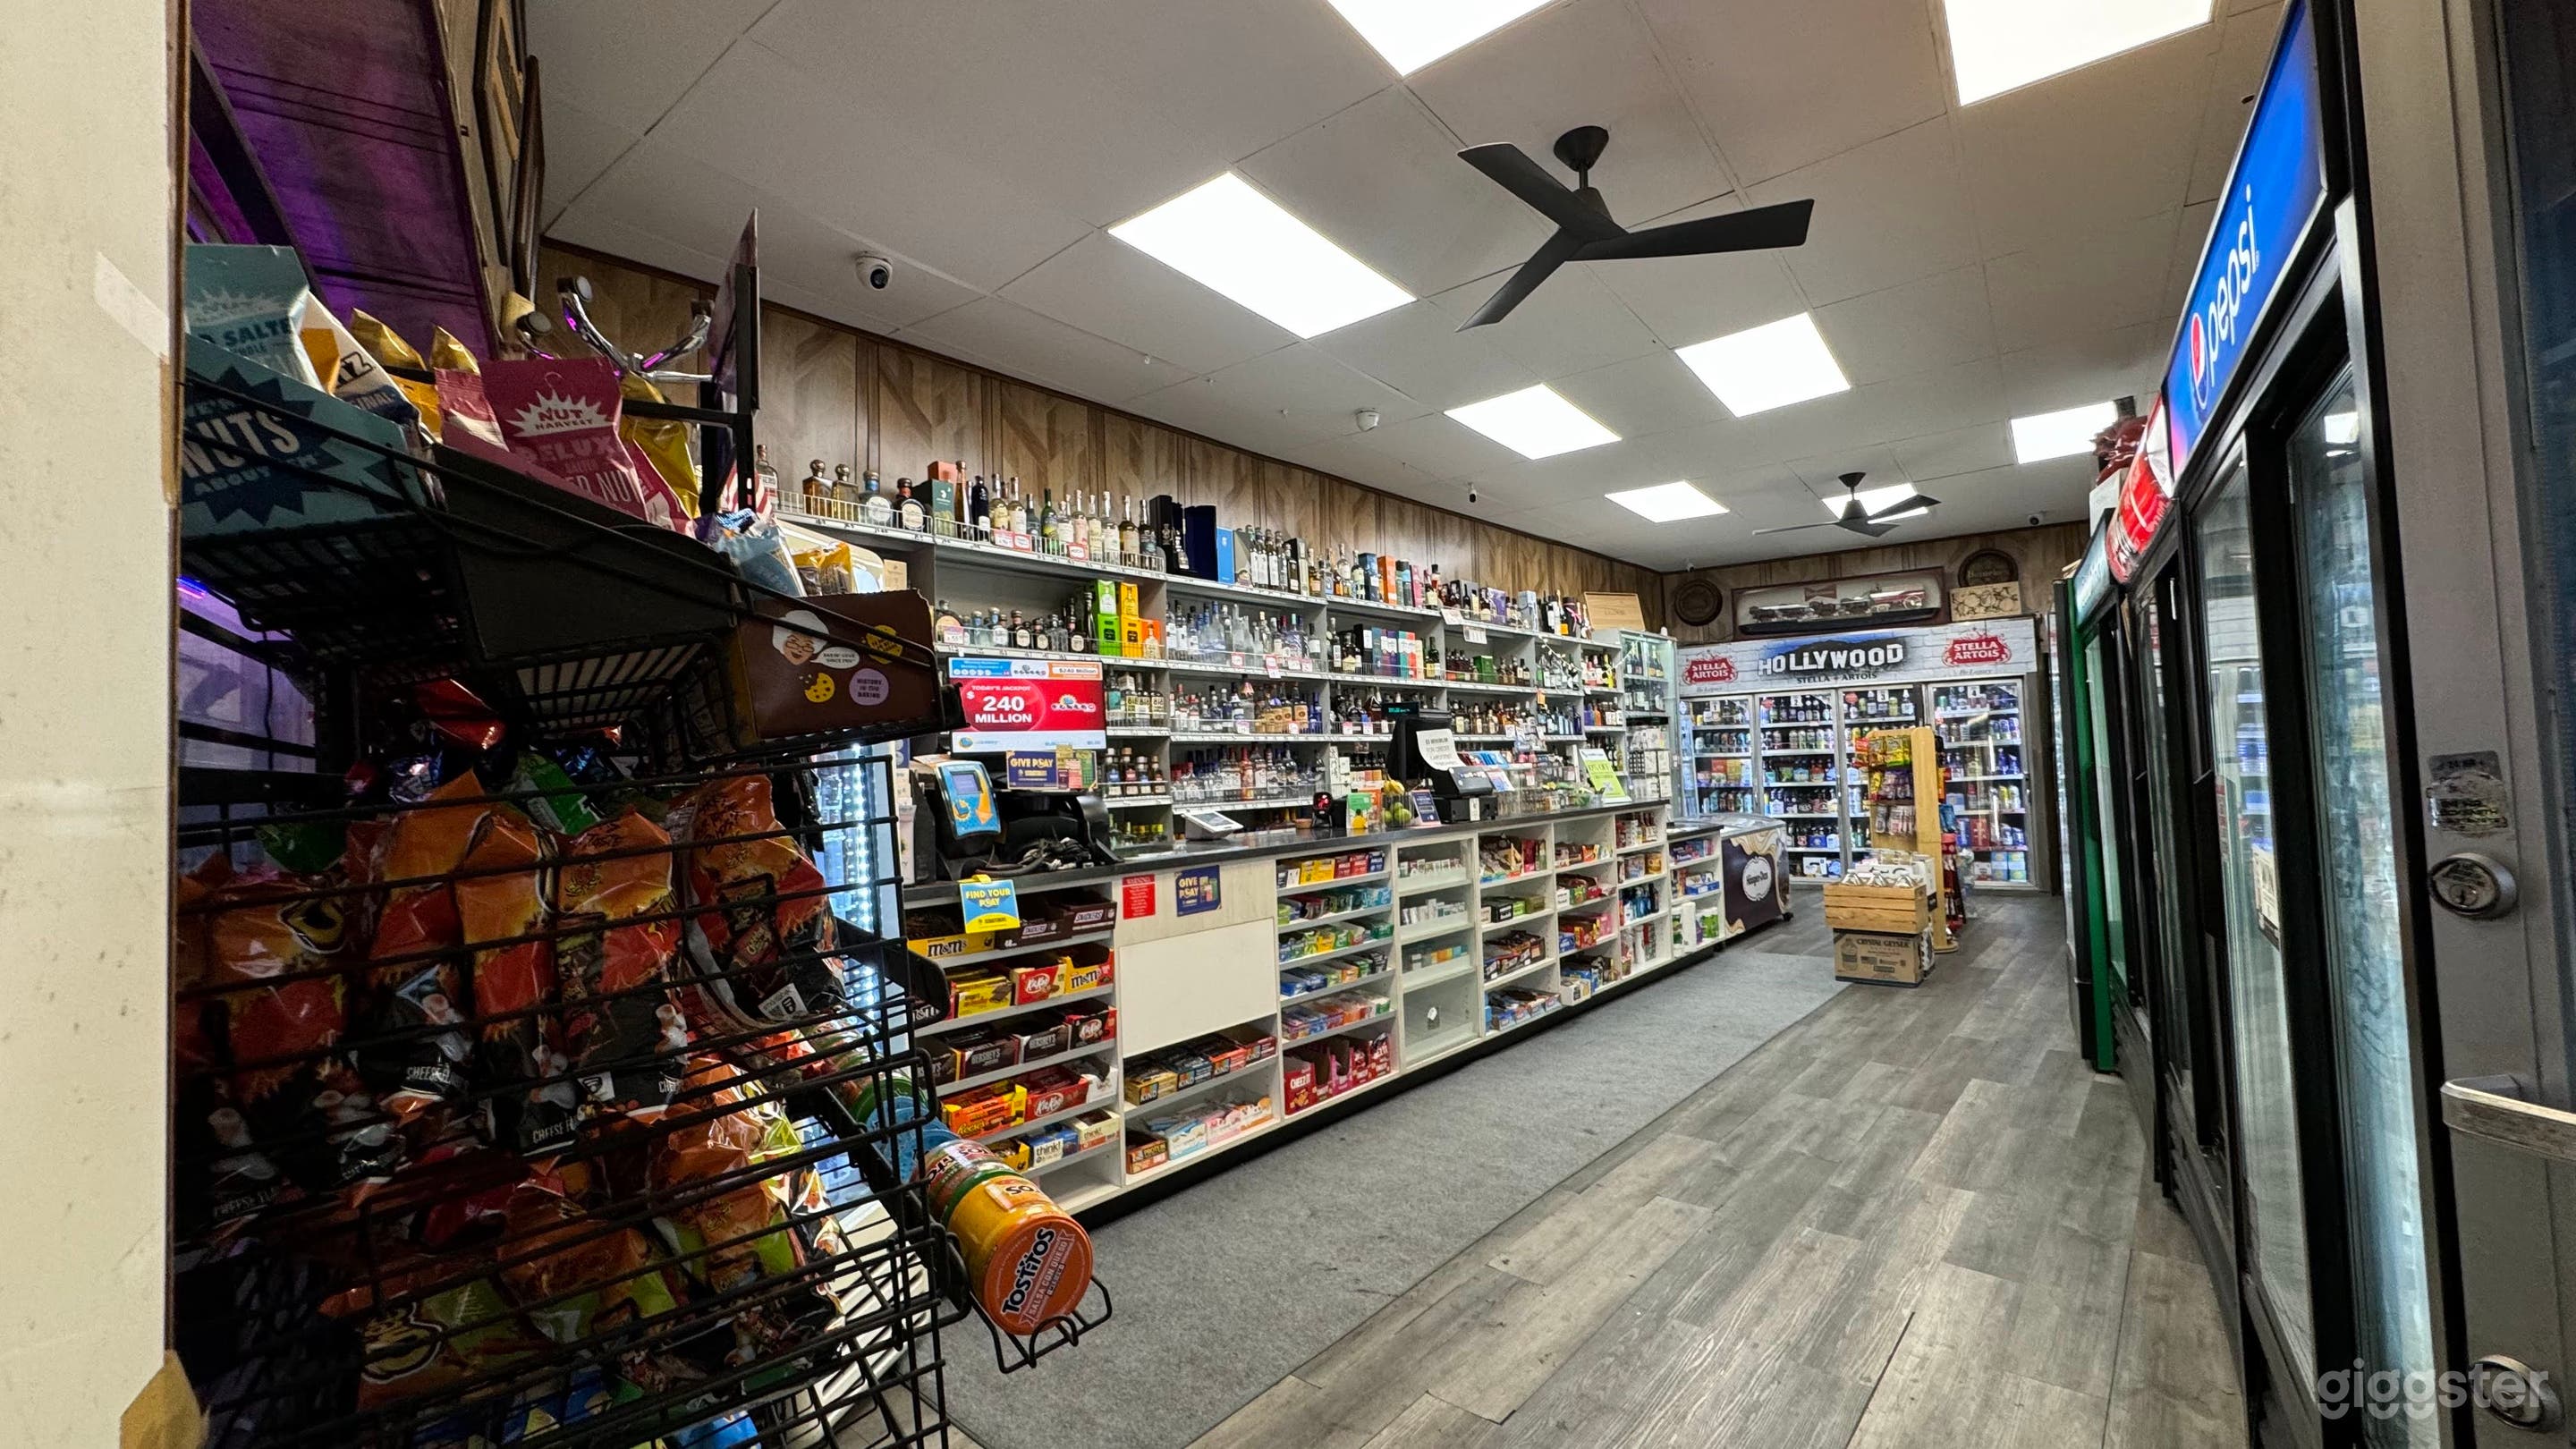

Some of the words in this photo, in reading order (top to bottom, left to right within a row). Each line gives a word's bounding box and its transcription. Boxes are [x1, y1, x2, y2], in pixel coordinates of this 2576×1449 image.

[2207, 183, 2257, 387] pepsi
[538, 408, 584, 422] NUT
[535, 418, 594, 430] HARVEST
[182, 408, 301, 479] NUTS
[1953, 640, 1998, 651] STELLA
[1758, 642, 1904, 676] HOLLYWOOD
[1954, 649, 2000, 660] ARTOIS
[1691, 662, 1727, 671] STELLA
[1691, 669, 1729, 679] ARTOIS
[1796, 675, 1831, 684] STELLA
[1841, 672, 1877, 682] ARTOIS
[966, 691, 975, 700] $
[982, 695, 1026, 712] 240
[974, 713, 1033, 724] MILLION
[1009, 758, 1031, 768] GIVE
[1178, 877, 1199, 888] GIVE
[965, 889, 986, 900] FIND
[987, 887, 1012, 898] YOUR
[1074, 910, 1104, 922] SNICKERS
[1023, 923, 1047, 936] SNICKERS
[1178, 1076, 1195, 1089] KIND
[1140, 1089, 1158, 1104] KIND
[532, 1124, 565, 1143] CHEESE
[1036, 1140, 1062, 1156] think!
[1143, 1142, 1167, 1157] PROTEIN
[1029, 1283, 1046, 1317] SALSA
[1042, 1266, 1054, 1288] CON
[1050, 1239, 1068, 1267] QUESO
